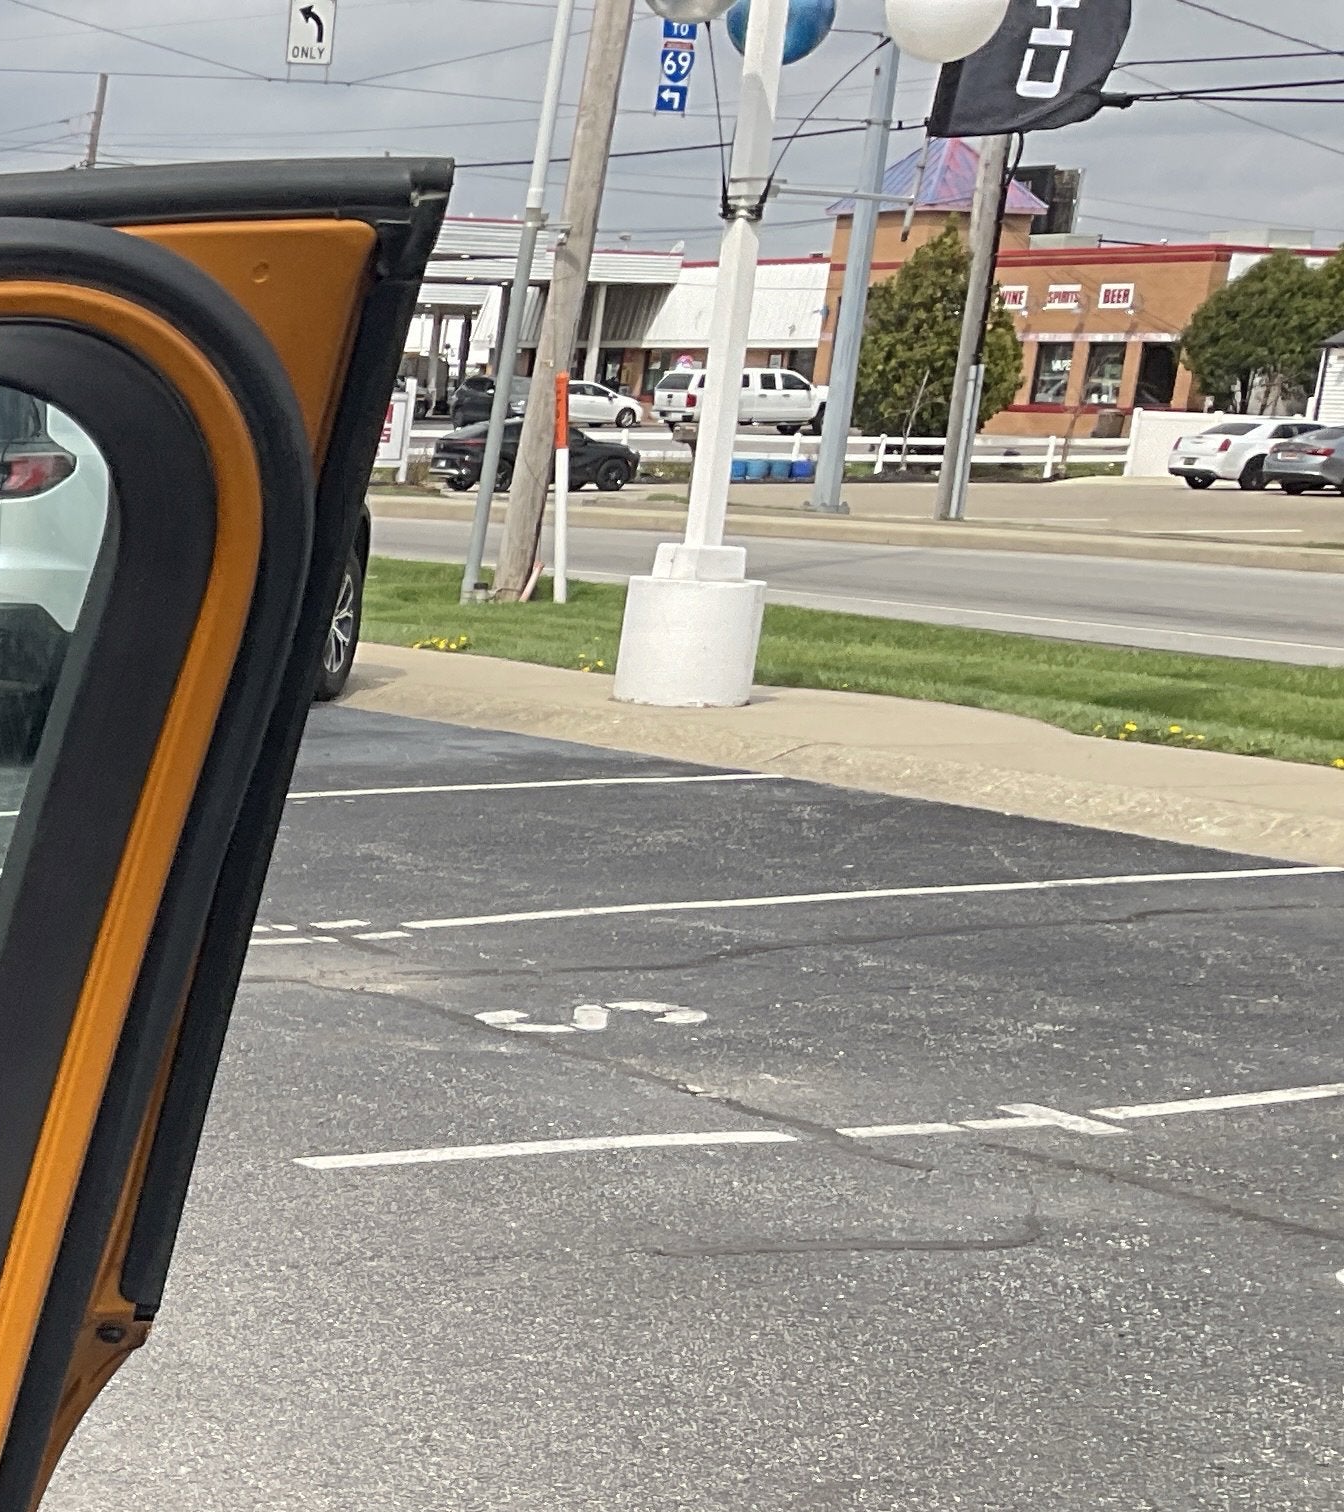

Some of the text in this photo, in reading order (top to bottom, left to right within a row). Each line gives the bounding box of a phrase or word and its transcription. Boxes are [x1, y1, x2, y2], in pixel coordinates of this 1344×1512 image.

[672, 22, 689, 36] TO
[291, 46, 325, 60] ONLY
[663, 52, 691, 75] 69
[1102, 289, 1131, 305] BEER
